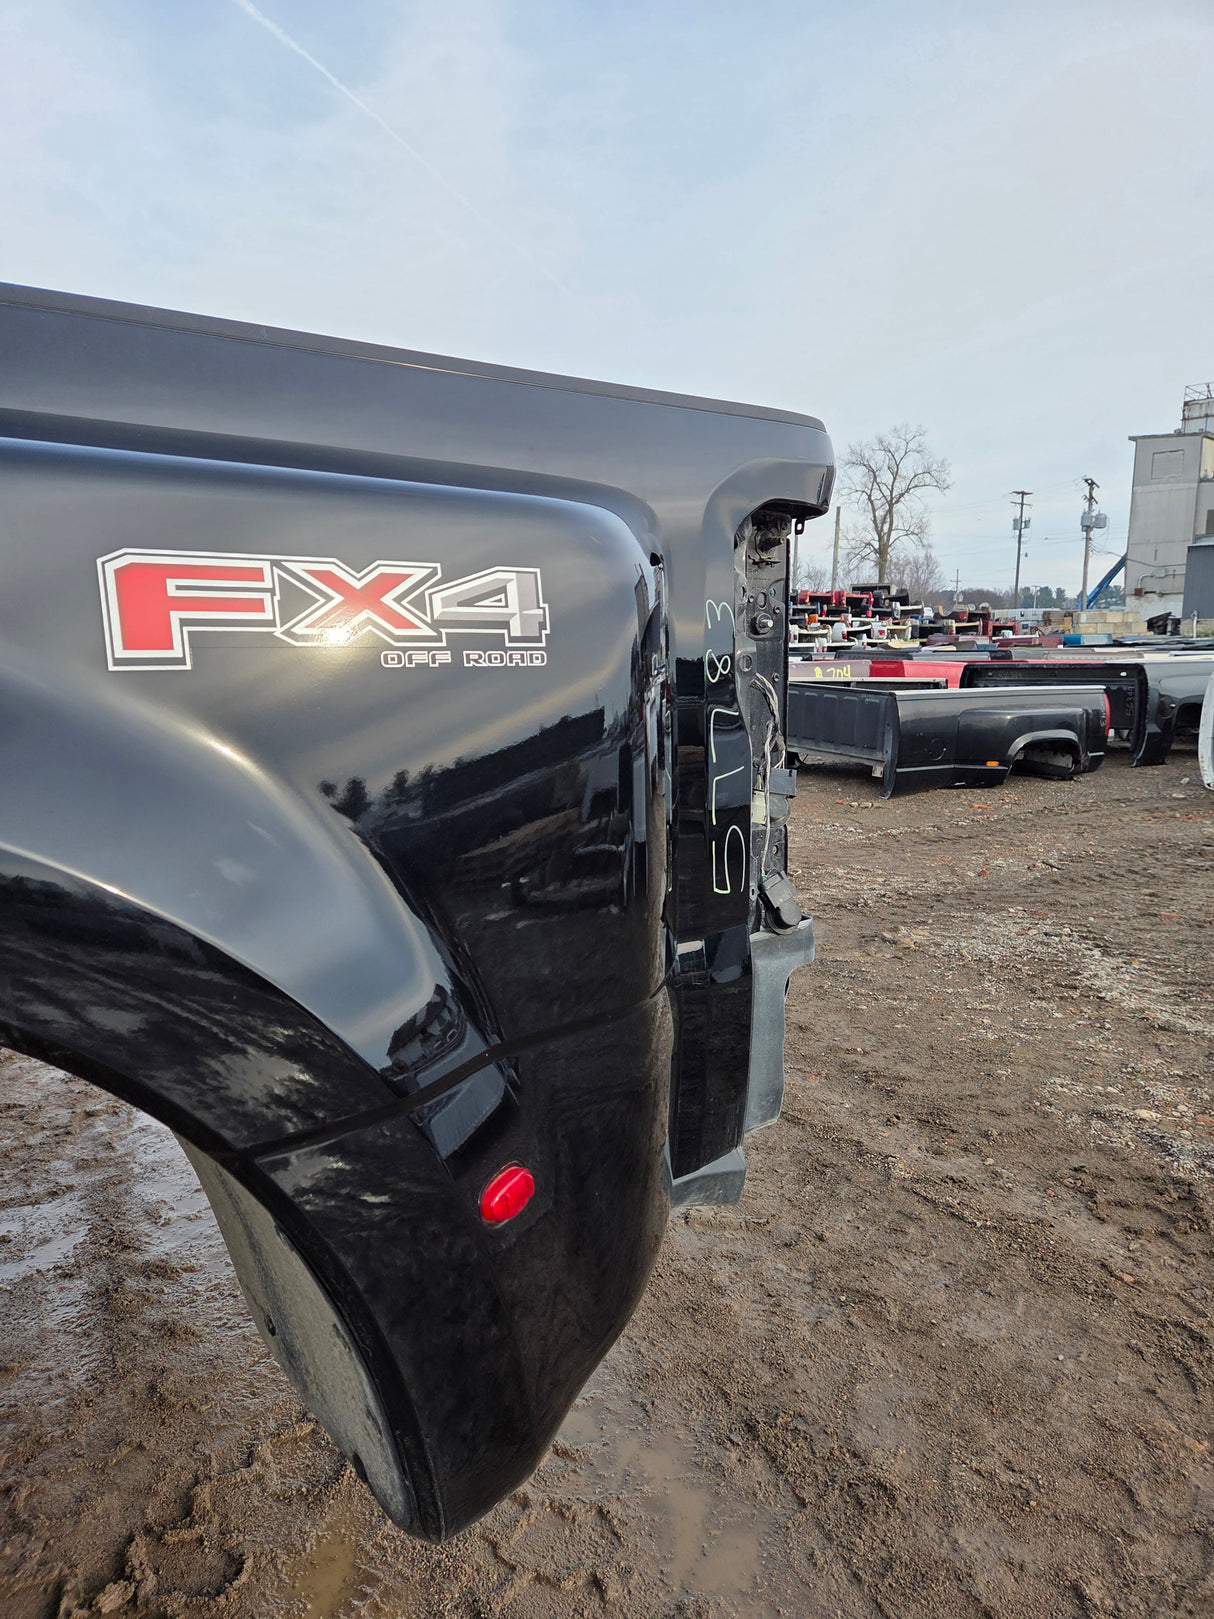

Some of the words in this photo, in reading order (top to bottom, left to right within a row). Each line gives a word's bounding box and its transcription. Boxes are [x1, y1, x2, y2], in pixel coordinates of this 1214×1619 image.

[97, 548, 550, 671] FX4
[381, 650, 452, 668] OFF
[463, 650, 547, 667] ROAD
